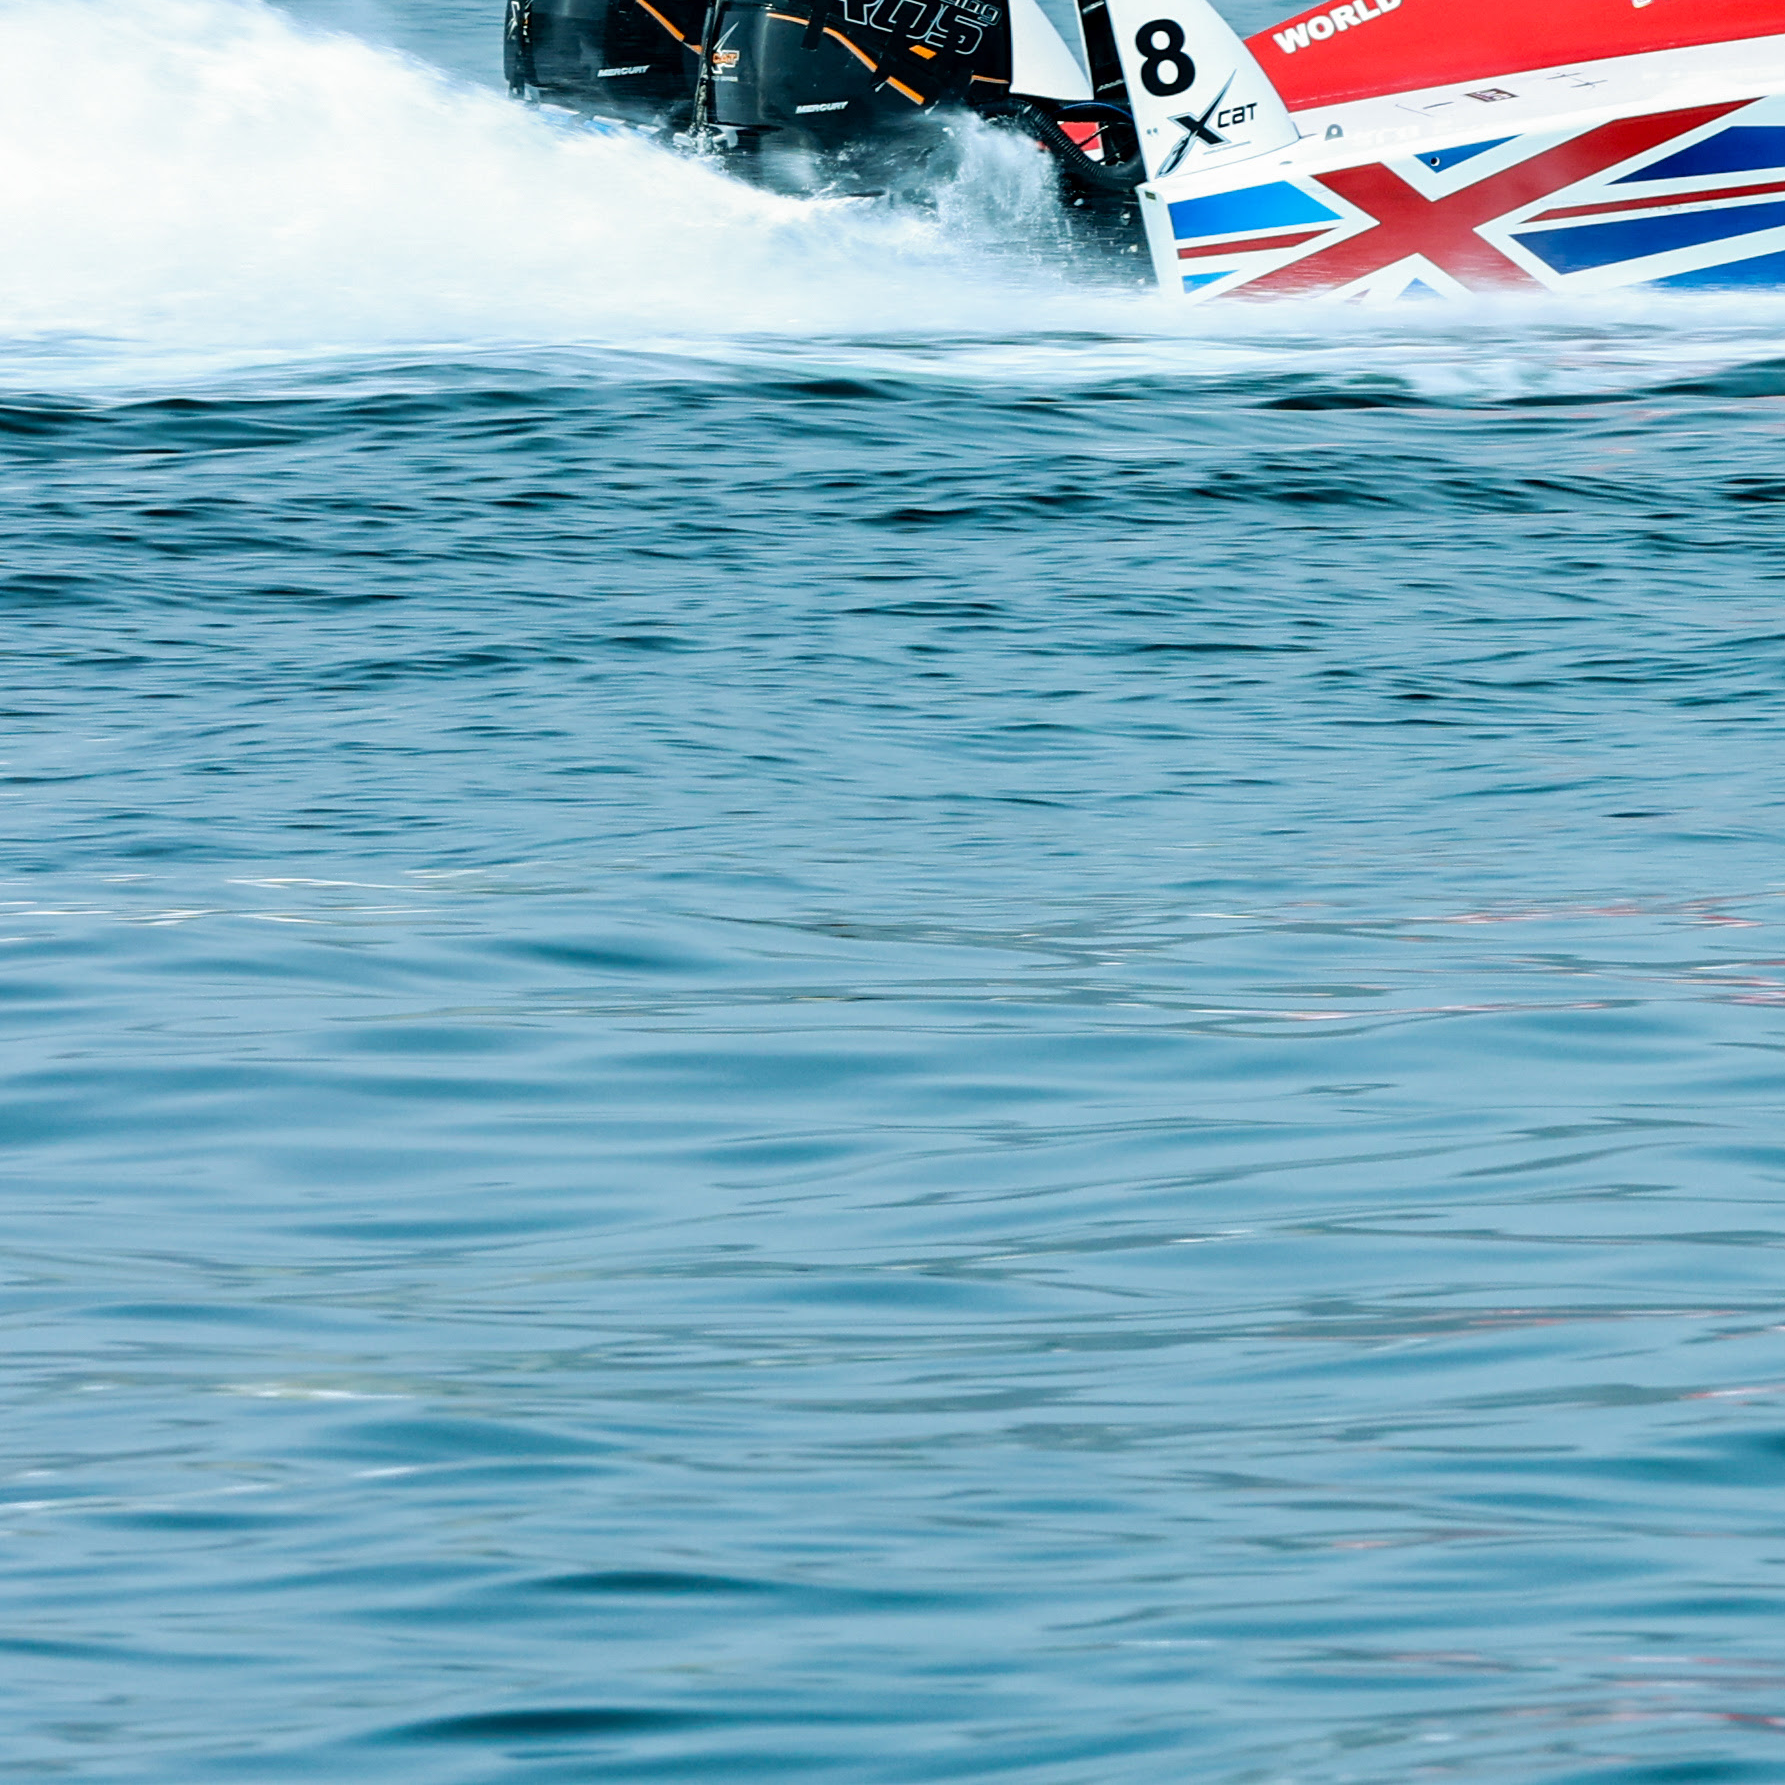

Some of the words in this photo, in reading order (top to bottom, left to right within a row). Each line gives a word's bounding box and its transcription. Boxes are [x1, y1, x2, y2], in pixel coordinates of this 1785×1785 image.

[1135, 18, 1196, 97] 8
[597, 65, 650, 78] MERCURY
[795, 101, 849, 114] MERCURY
